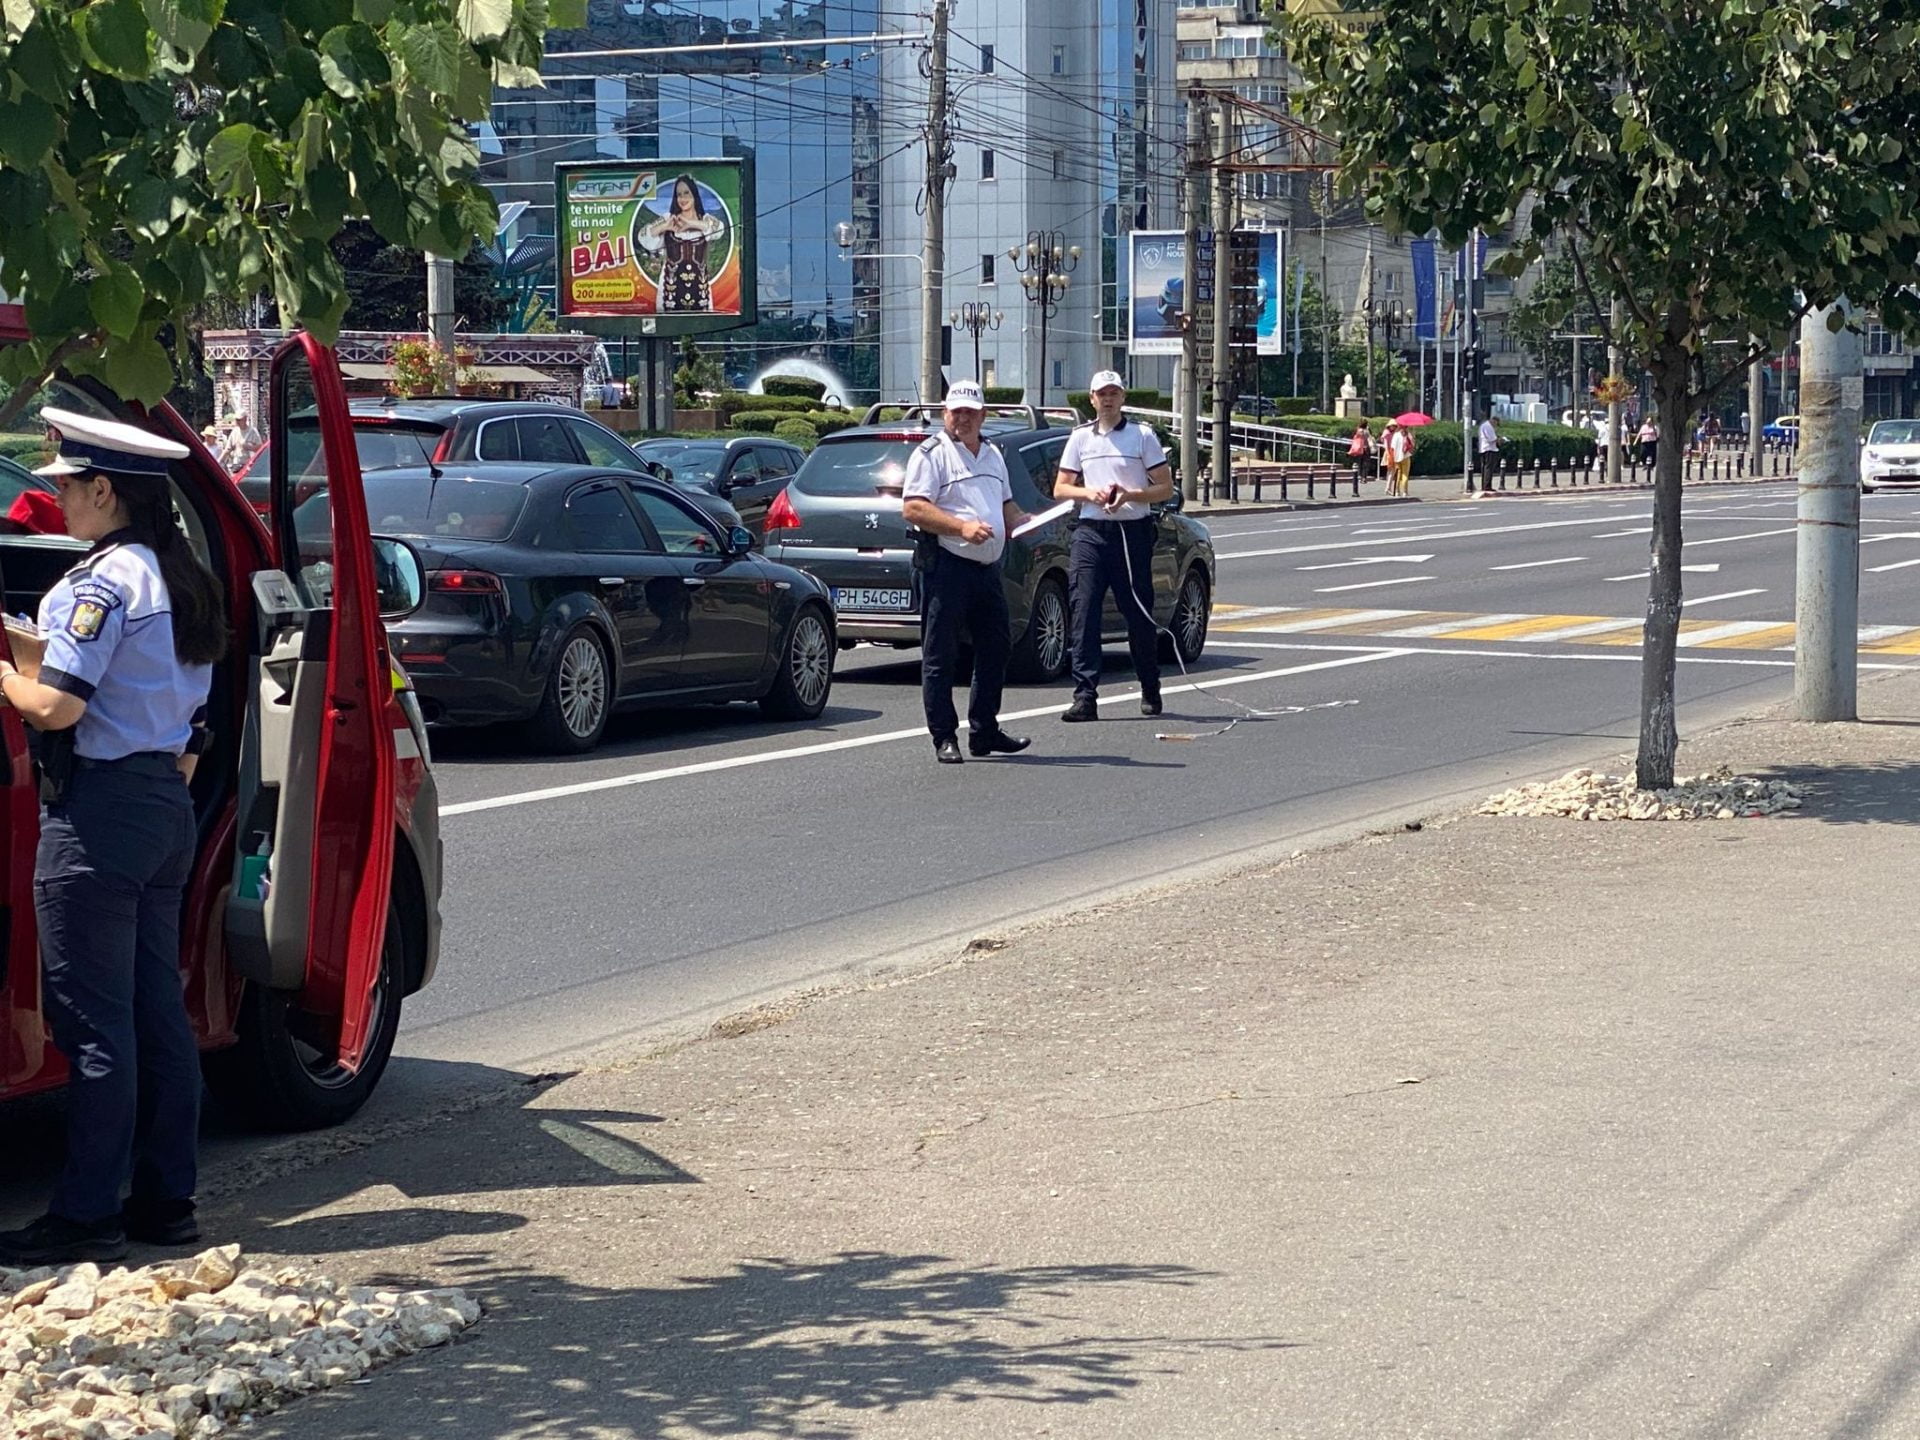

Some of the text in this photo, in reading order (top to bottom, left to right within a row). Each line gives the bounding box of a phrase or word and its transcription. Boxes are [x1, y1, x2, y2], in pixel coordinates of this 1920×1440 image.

[577, 182, 631, 194] CATENA
[570, 203, 623, 215] te trimite
[571, 217, 614, 228] din nou
[578, 231, 592, 244] la
[571, 231, 627, 277] BĂI
[576, 289, 594, 299] 200
[595, 290, 604, 299] de
[838, 590, 910, 605] PH 54CGH
